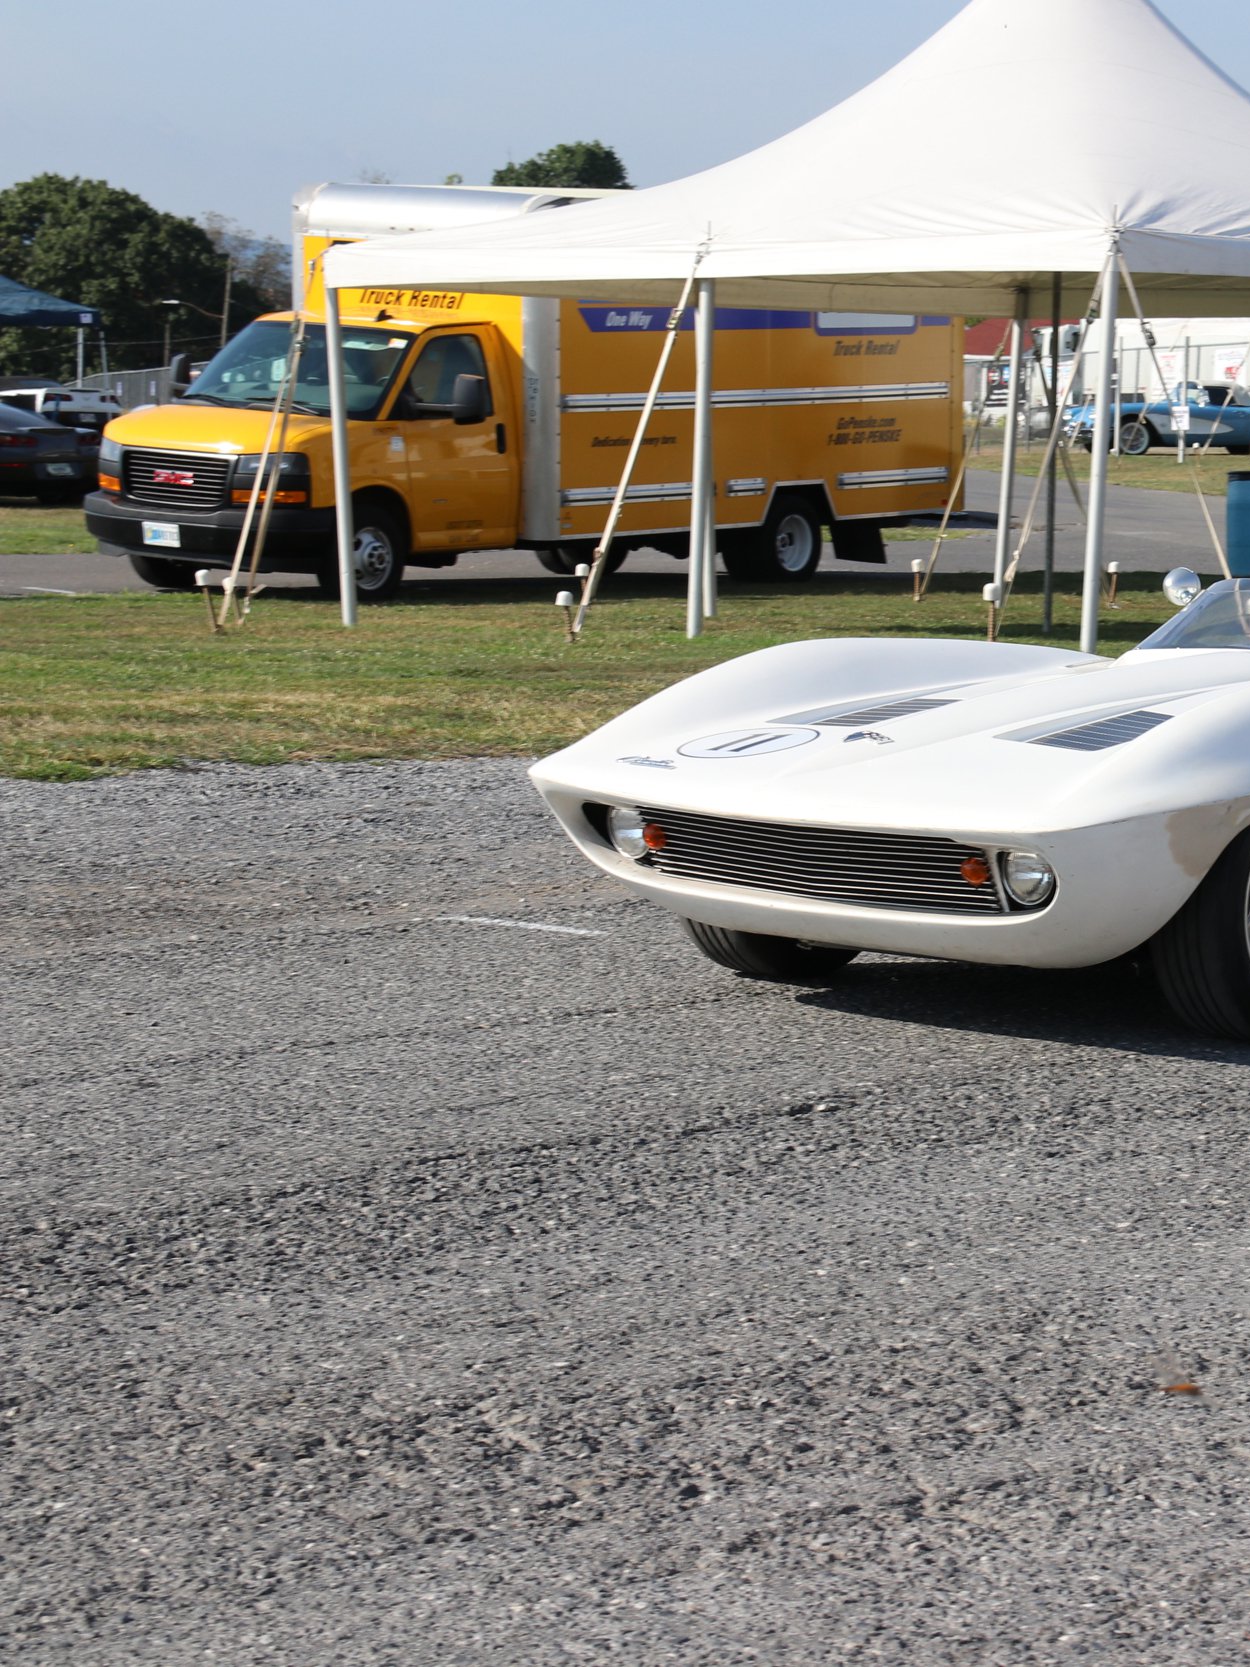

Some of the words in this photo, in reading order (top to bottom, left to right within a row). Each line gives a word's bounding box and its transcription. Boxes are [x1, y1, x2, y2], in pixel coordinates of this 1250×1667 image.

[407, 290, 464, 310] Rental
[605, 311, 627, 327] One
[628, 310, 653, 330] Way
[833, 340, 863, 356] Truck
[864, 340, 900, 355] Rental
[706, 732, 793, 752] 11
